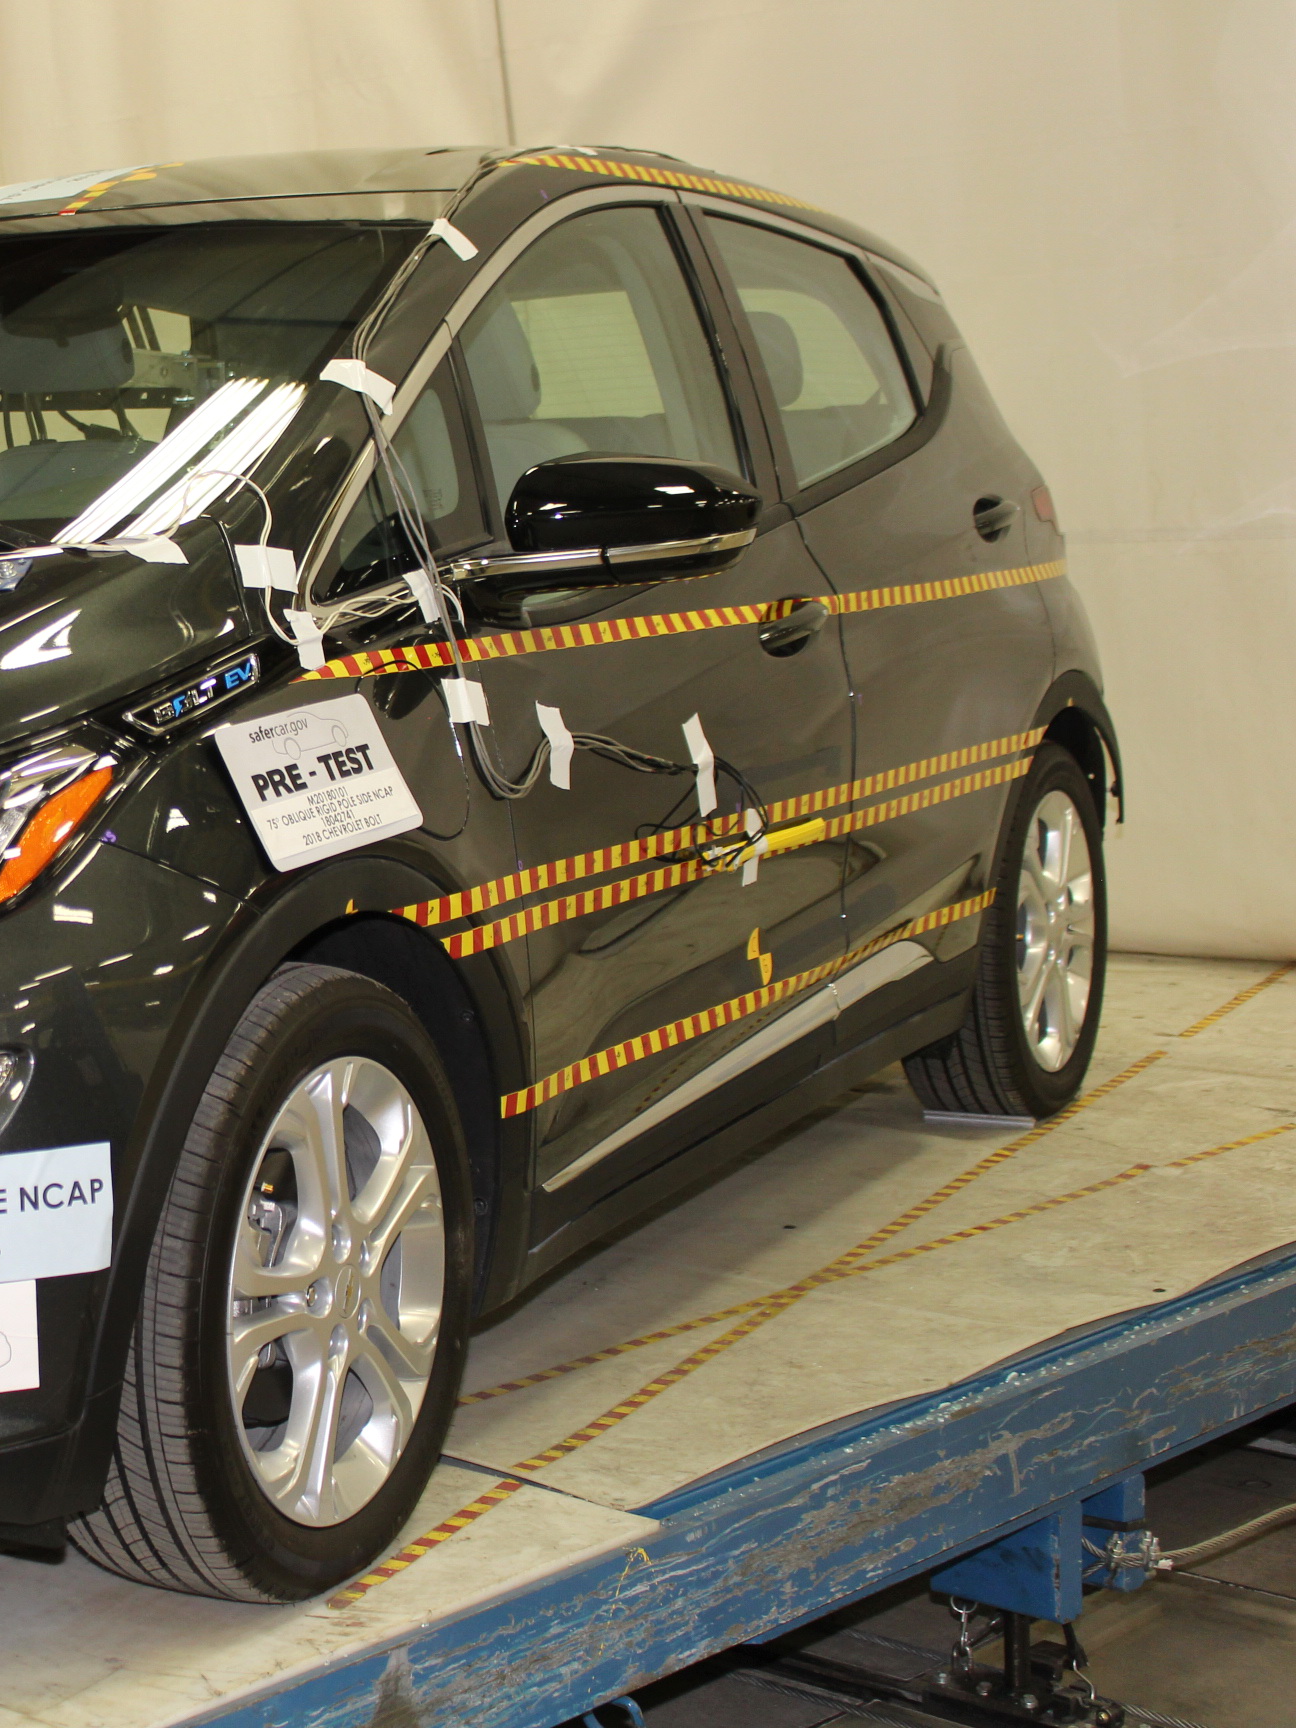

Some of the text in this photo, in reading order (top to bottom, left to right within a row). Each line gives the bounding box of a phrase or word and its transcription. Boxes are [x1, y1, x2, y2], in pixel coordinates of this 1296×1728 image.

[224, 662, 251, 689] EV
[248, 717, 309, 744] safercar.gov
[250, 763, 308, 802] PRE
[316, 743, 375, 782] TEST
[281, 807, 316, 826] OBLIQUE
[316, 802, 338, 817] RIGID
[338, 797, 358, 811] POLE
[358, 791, 374, 805] SIDE
[372, 785, 394, 802] NCAP
[307, 785, 349, 806] M20180101
[302, 813, 383, 846] 2018 CHEVROLET BOLT
[320, 809, 355, 828] 18042741
[19, 1178, 104, 1212] NCAP
